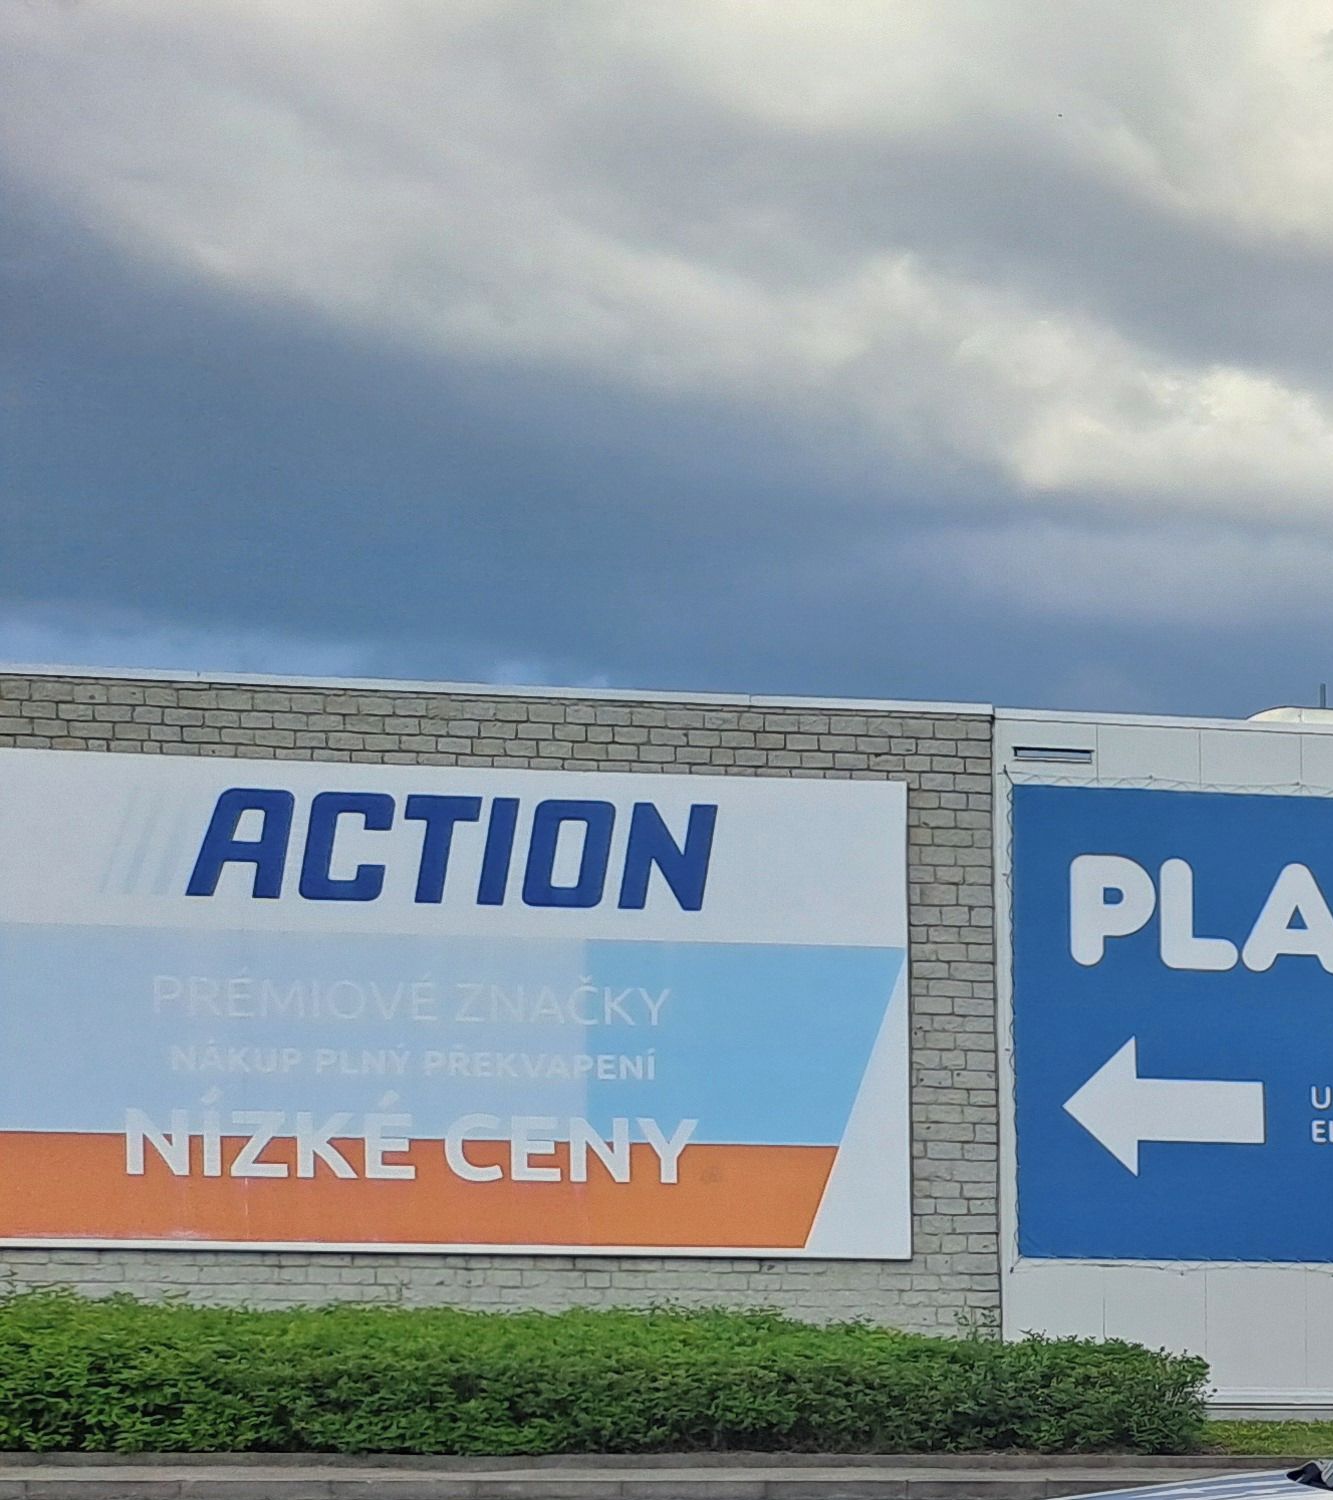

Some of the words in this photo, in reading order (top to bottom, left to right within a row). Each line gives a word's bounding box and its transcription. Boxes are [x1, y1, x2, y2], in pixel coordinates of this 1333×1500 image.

[186, 787, 718, 911] ACTION
[152, 966, 438, 1023] PRÉMIOVÉ
[455, 975, 671, 1026] ZNAČKY
[169, 1039, 301, 1075] NÁKUP
[315, 1043, 411, 1075] PLNÝ
[424, 1043, 656, 1080] PŘEKVAPENÍ
[1311, 1086, 1331, 1109] U
[124, 1085, 416, 1181] NÍZKÉ
[443, 1112, 698, 1185] CENY
